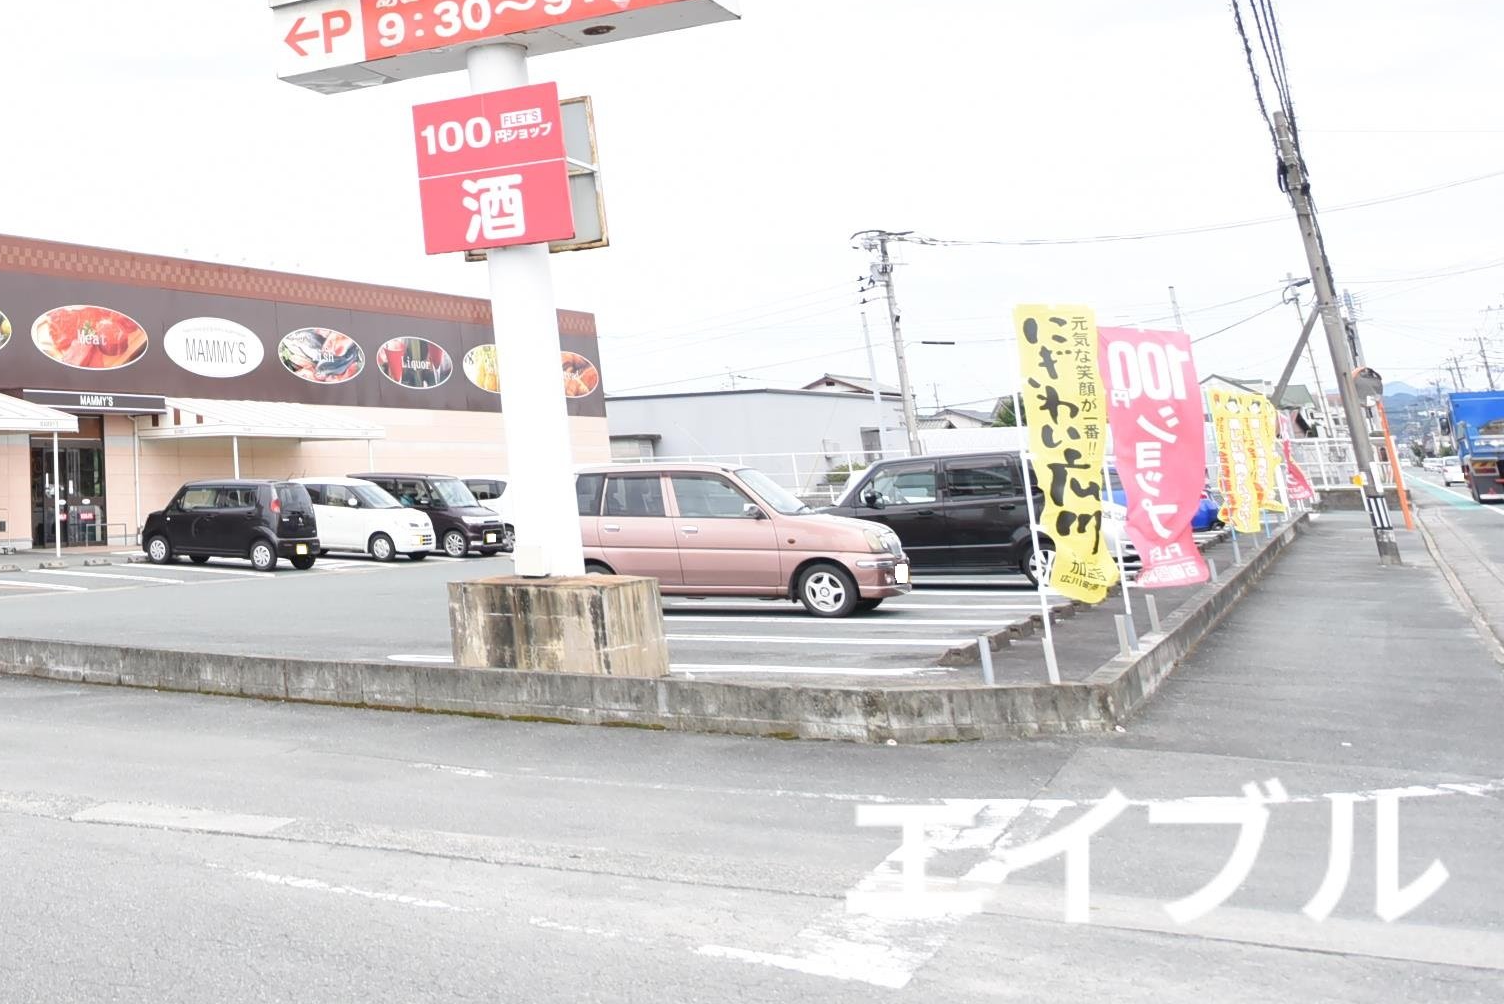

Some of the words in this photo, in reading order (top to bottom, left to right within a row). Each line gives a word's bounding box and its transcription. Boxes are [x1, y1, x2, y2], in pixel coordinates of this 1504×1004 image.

[321, 9, 352, 54] P
[503, 111, 540, 125] FLET'S
[420, 116, 492, 155] 100
[494, 122, 553, 144] 円ショップ
[461, 174, 526, 243] 酒
[185, 337, 247, 365] MAMMY'S
[312, 347, 335, 363] ish
[401, 355, 432, 371] Liquor
[80, 394, 114, 407] MAMMY'S
[1022, 317, 1102, 555] にぎわい広川
